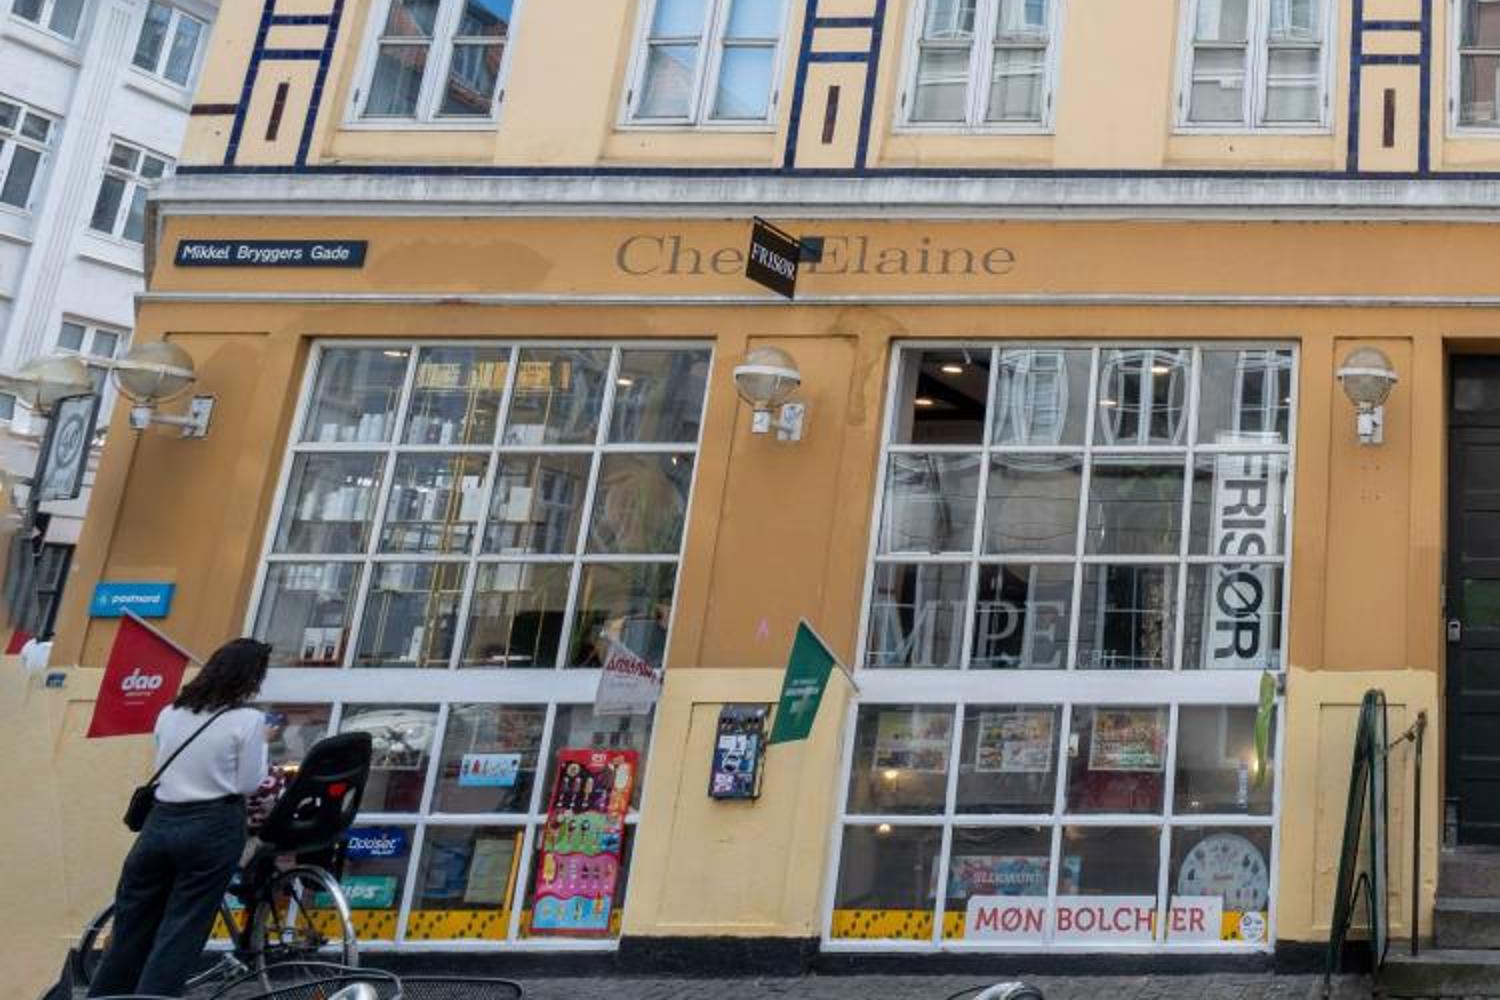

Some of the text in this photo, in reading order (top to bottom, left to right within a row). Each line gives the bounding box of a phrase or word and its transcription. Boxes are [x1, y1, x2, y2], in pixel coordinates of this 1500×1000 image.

[182, 245, 349, 263] Mikkel Bryggers Gade
[616, 235, 1014, 275] Che Elaine
[751, 242, 796, 281] FRISØR
[974, 906, 1045, 932] MØN
